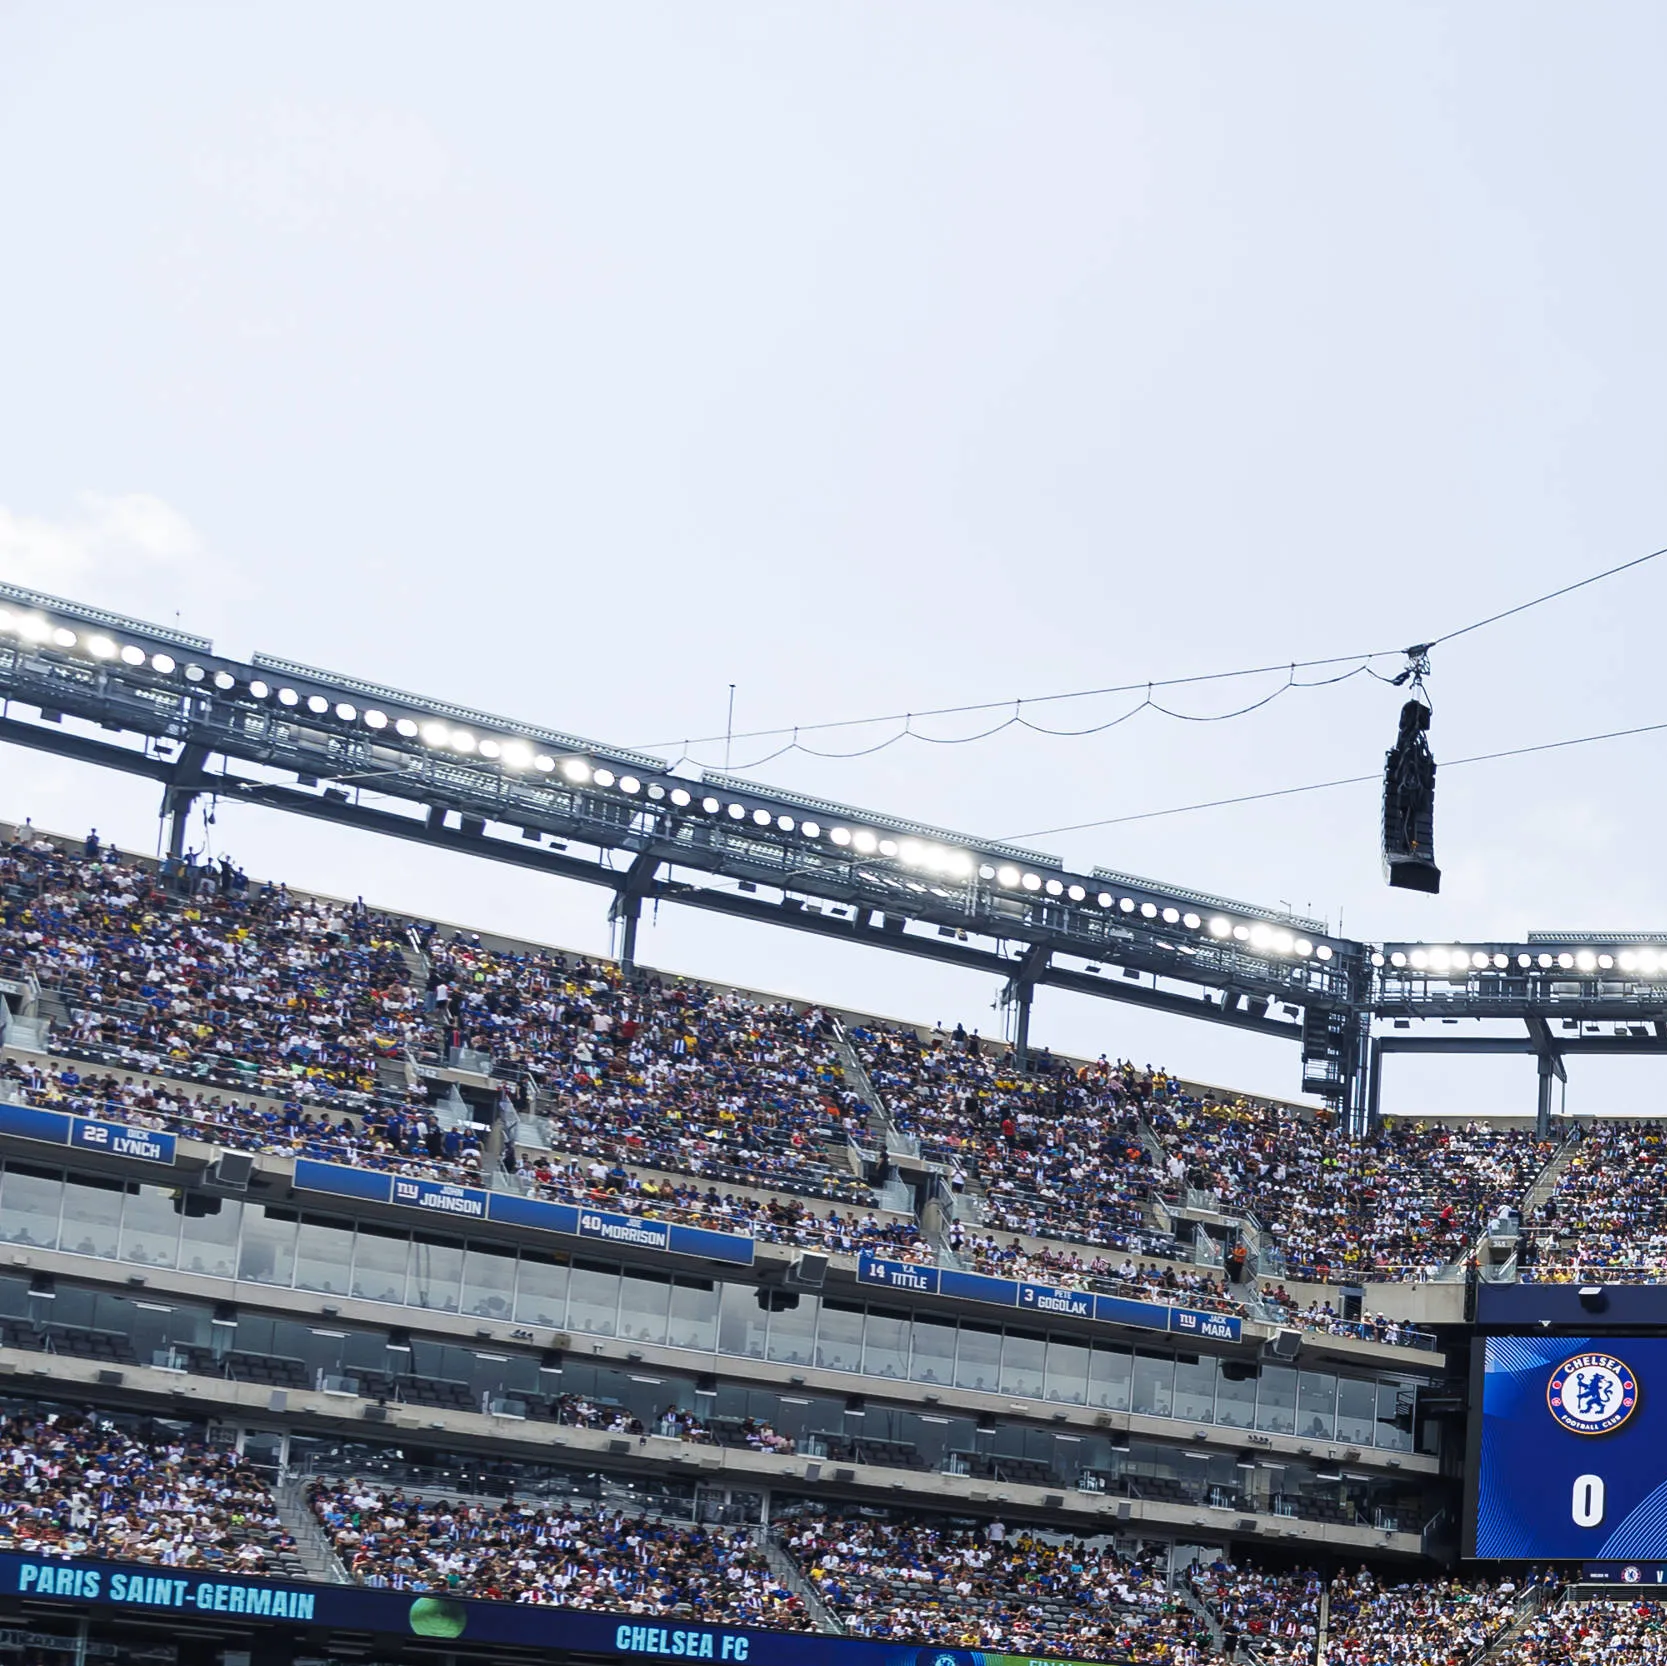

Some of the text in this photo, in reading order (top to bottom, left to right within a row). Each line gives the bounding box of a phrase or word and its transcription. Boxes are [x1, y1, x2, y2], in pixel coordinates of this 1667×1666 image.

[82, 1125, 109, 1144] 22
[126, 1128, 150, 1141] DICK
[113, 1137, 161, 1159] LYNCH
[440, 1184, 464, 1198] JOHN
[419, 1193, 482, 1216] JOHNSON
[581, 1215, 601, 1231] 40
[626, 1218, 642, 1229] JOE
[600, 1223, 666, 1247] MORRISON
[869, 1263, 885, 1279] 14
[902, 1264, 917, 1275] Y.A.
[891, 1271, 927, 1290] TITTLE
[1024, 1289, 1034, 1303] 3
[1054, 1289, 1072, 1300] PETE
[1037, 1296, 1087, 1316] GOGOLAK
[1208, 1314, 1226, 1325] JACK
[1202, 1322, 1232, 1339] MARA
[1564, 1356, 1622, 1374] CHELSEA
[1561, 1414, 1600, 1430] FOOTBALL
[1602, 1414, 1622, 1429] CLUB
[1571, 1474, 1604, 1528] 0
[1655, 1570, 1664, 1584] V
[19, 1564, 315, 1620] PARIS SAINT-GERMAIN
[615, 1625, 749, 1661] CHELSEA FC
